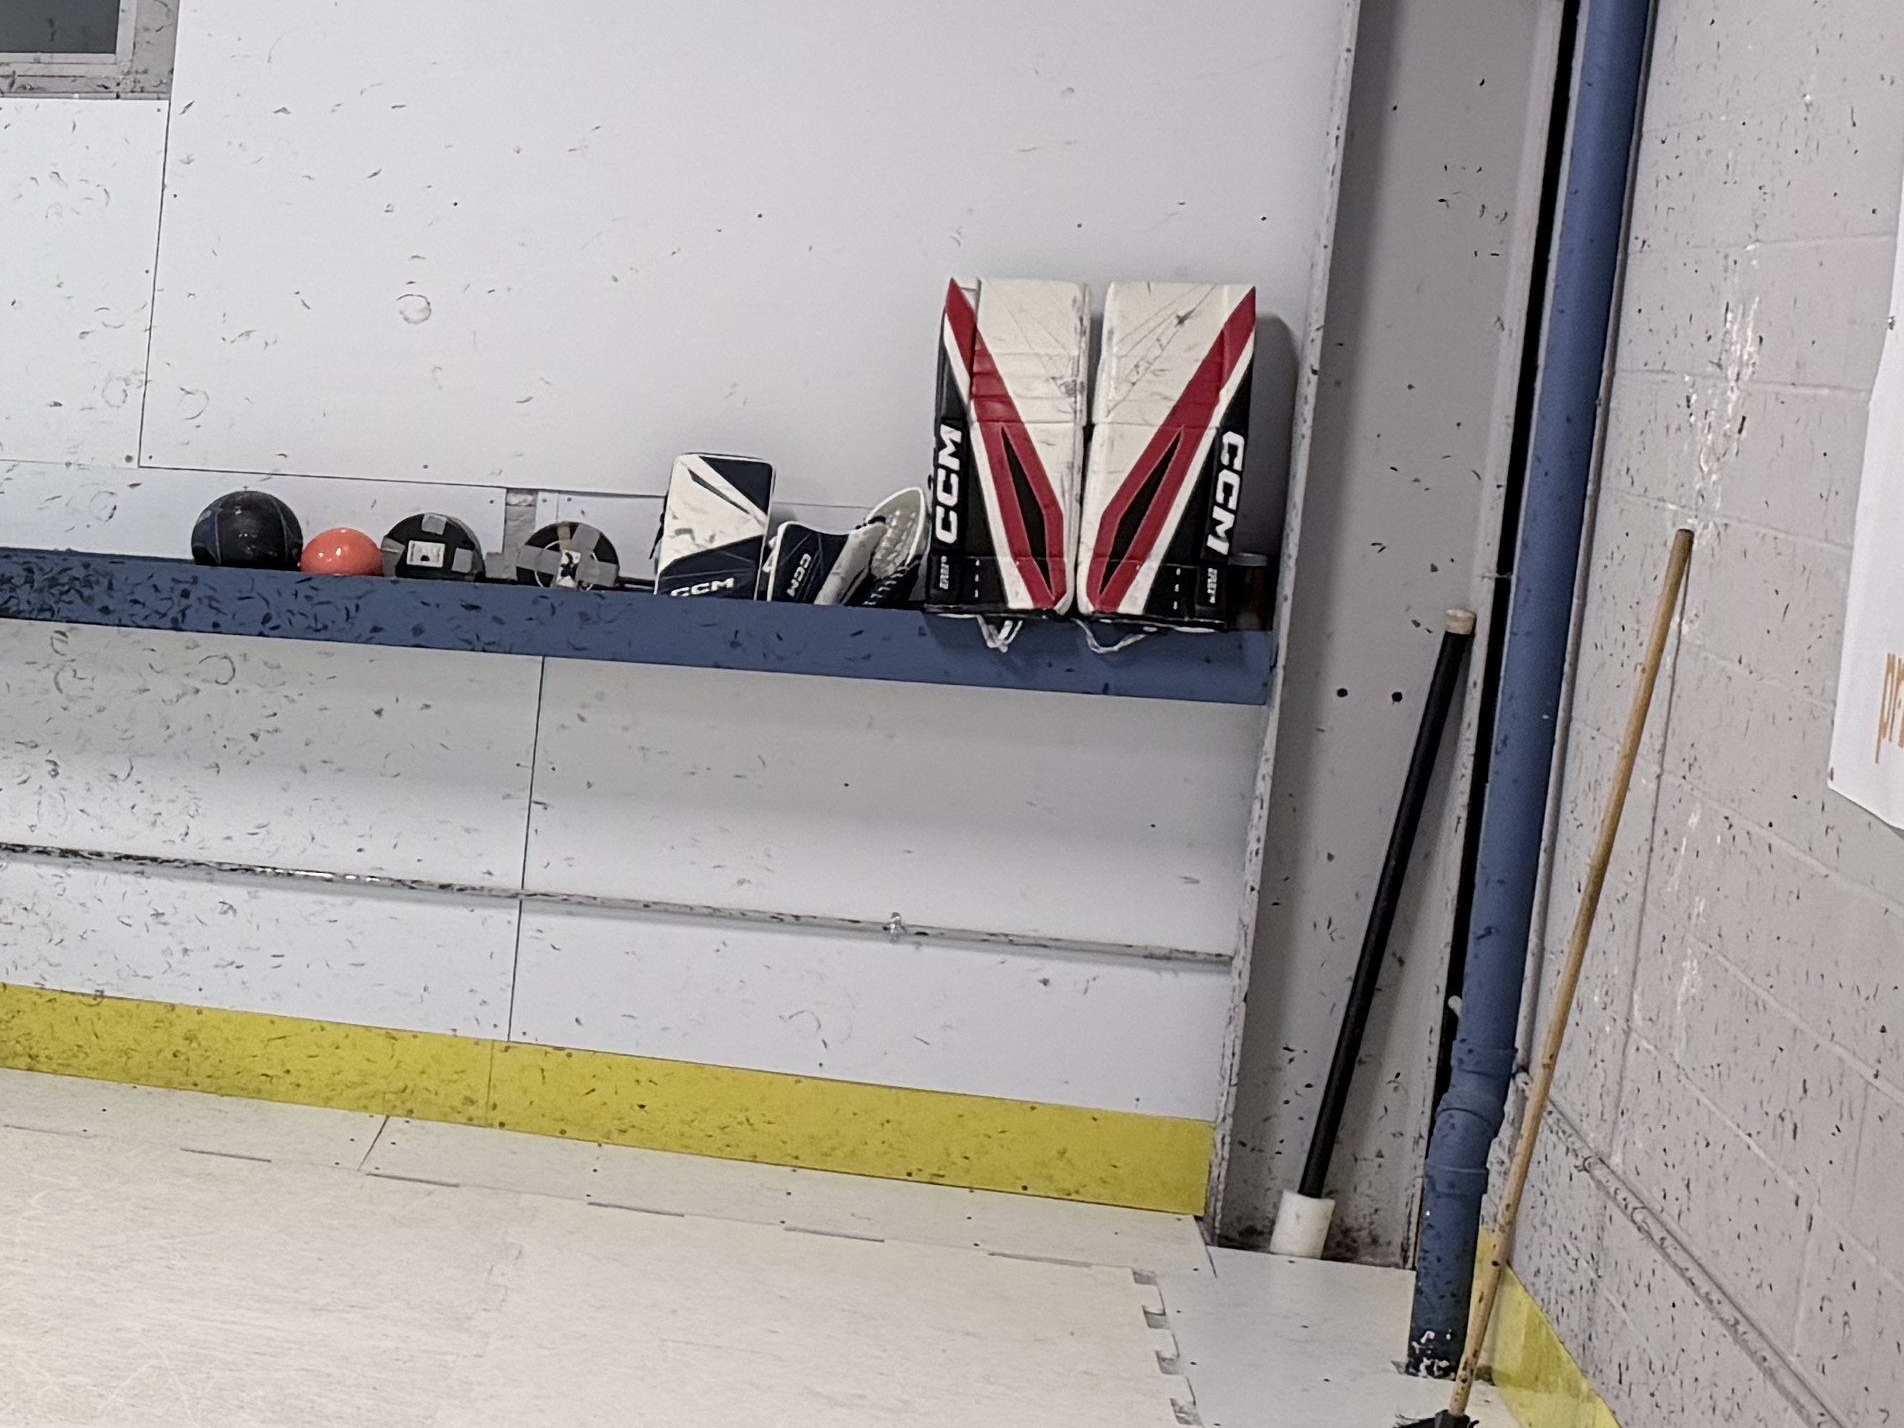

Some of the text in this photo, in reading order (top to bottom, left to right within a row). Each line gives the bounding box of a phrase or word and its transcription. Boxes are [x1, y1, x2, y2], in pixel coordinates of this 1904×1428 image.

[936, 424, 962, 545] CCM
[1206, 430, 1245, 556] CCM
[670, 577, 735, 597] CCM
[786, 553, 812, 597] CCM
